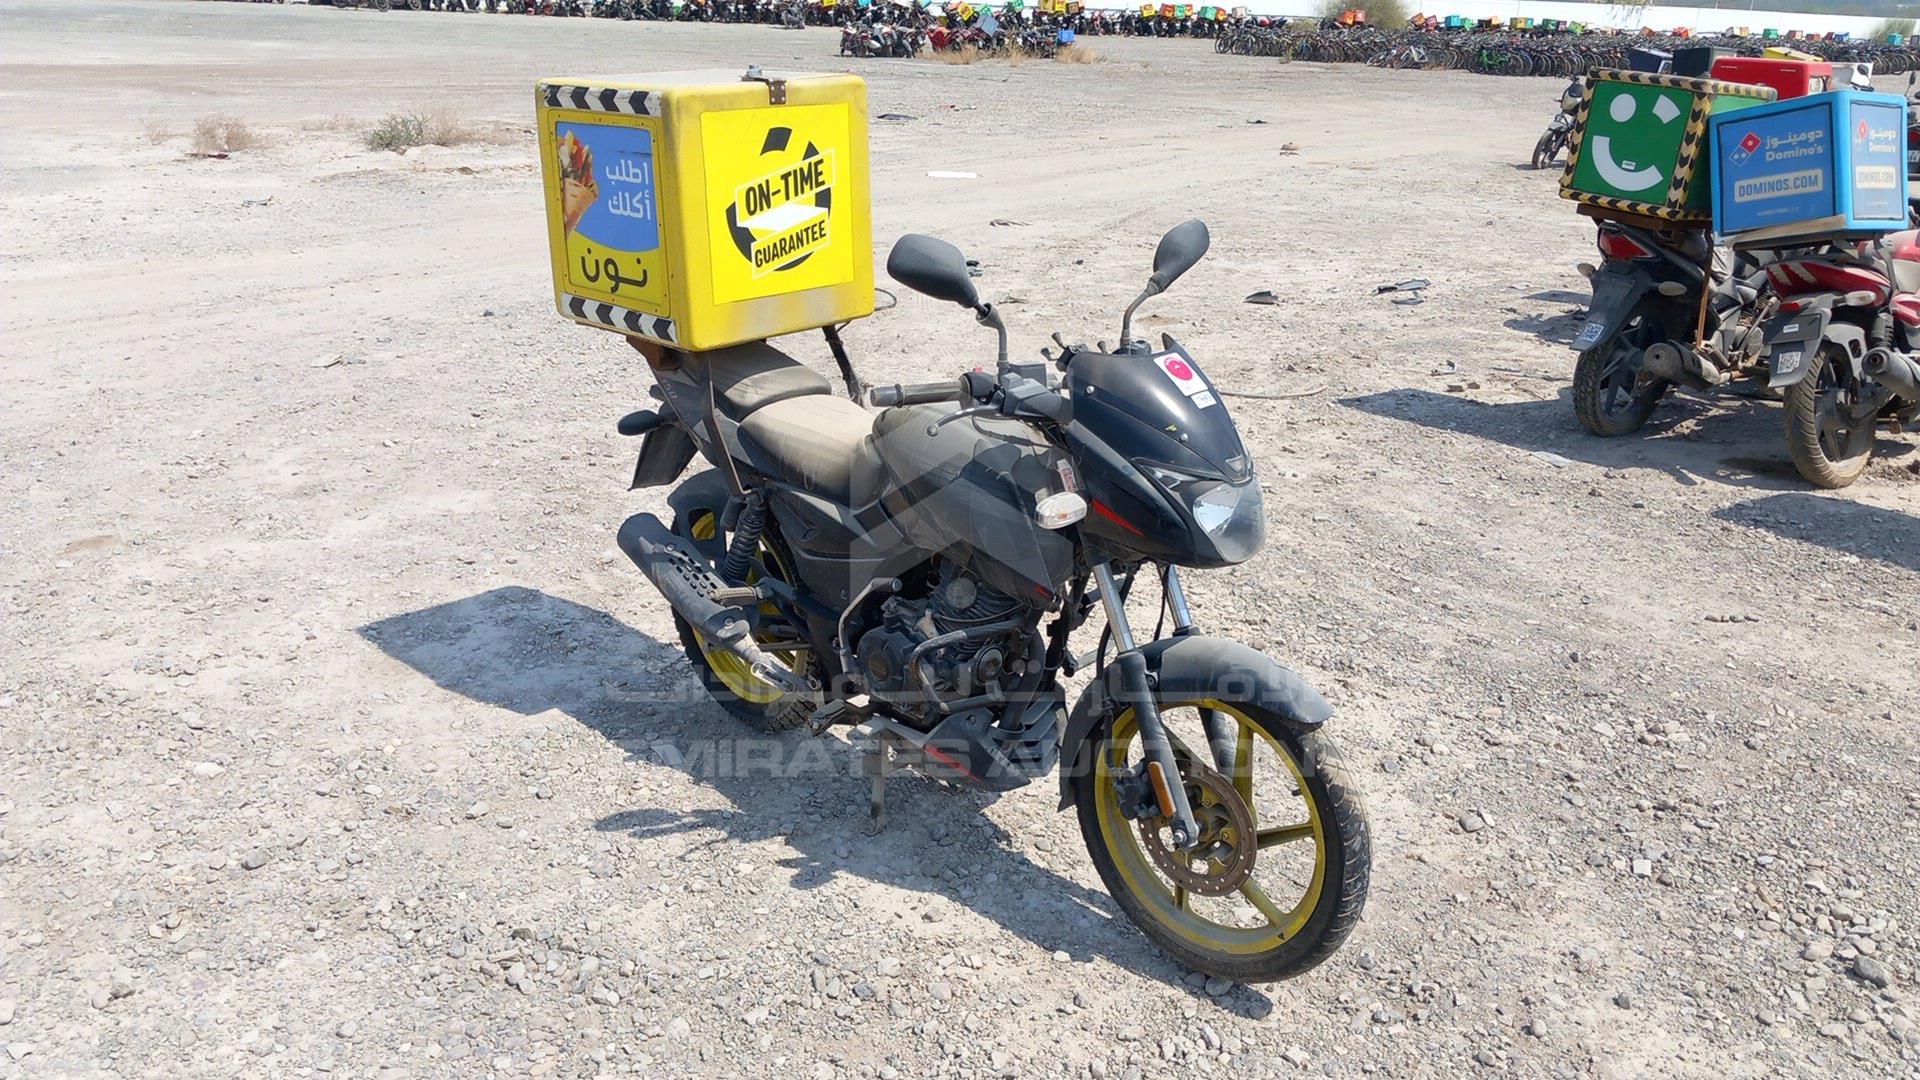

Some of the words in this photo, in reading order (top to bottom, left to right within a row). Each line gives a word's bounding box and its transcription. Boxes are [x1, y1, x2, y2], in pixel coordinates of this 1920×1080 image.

[1765, 129, 1824, 149] دومينوز
[1765, 144, 1824, 161] Domino's
[605, 157, 649, 185] اطلب
[745, 157, 826, 216] ON-TIME
[1738, 174, 1818, 197] DOMINOS.COM
[754, 219, 827, 269] GUARANTEE
[580, 247, 648, 293] نون
